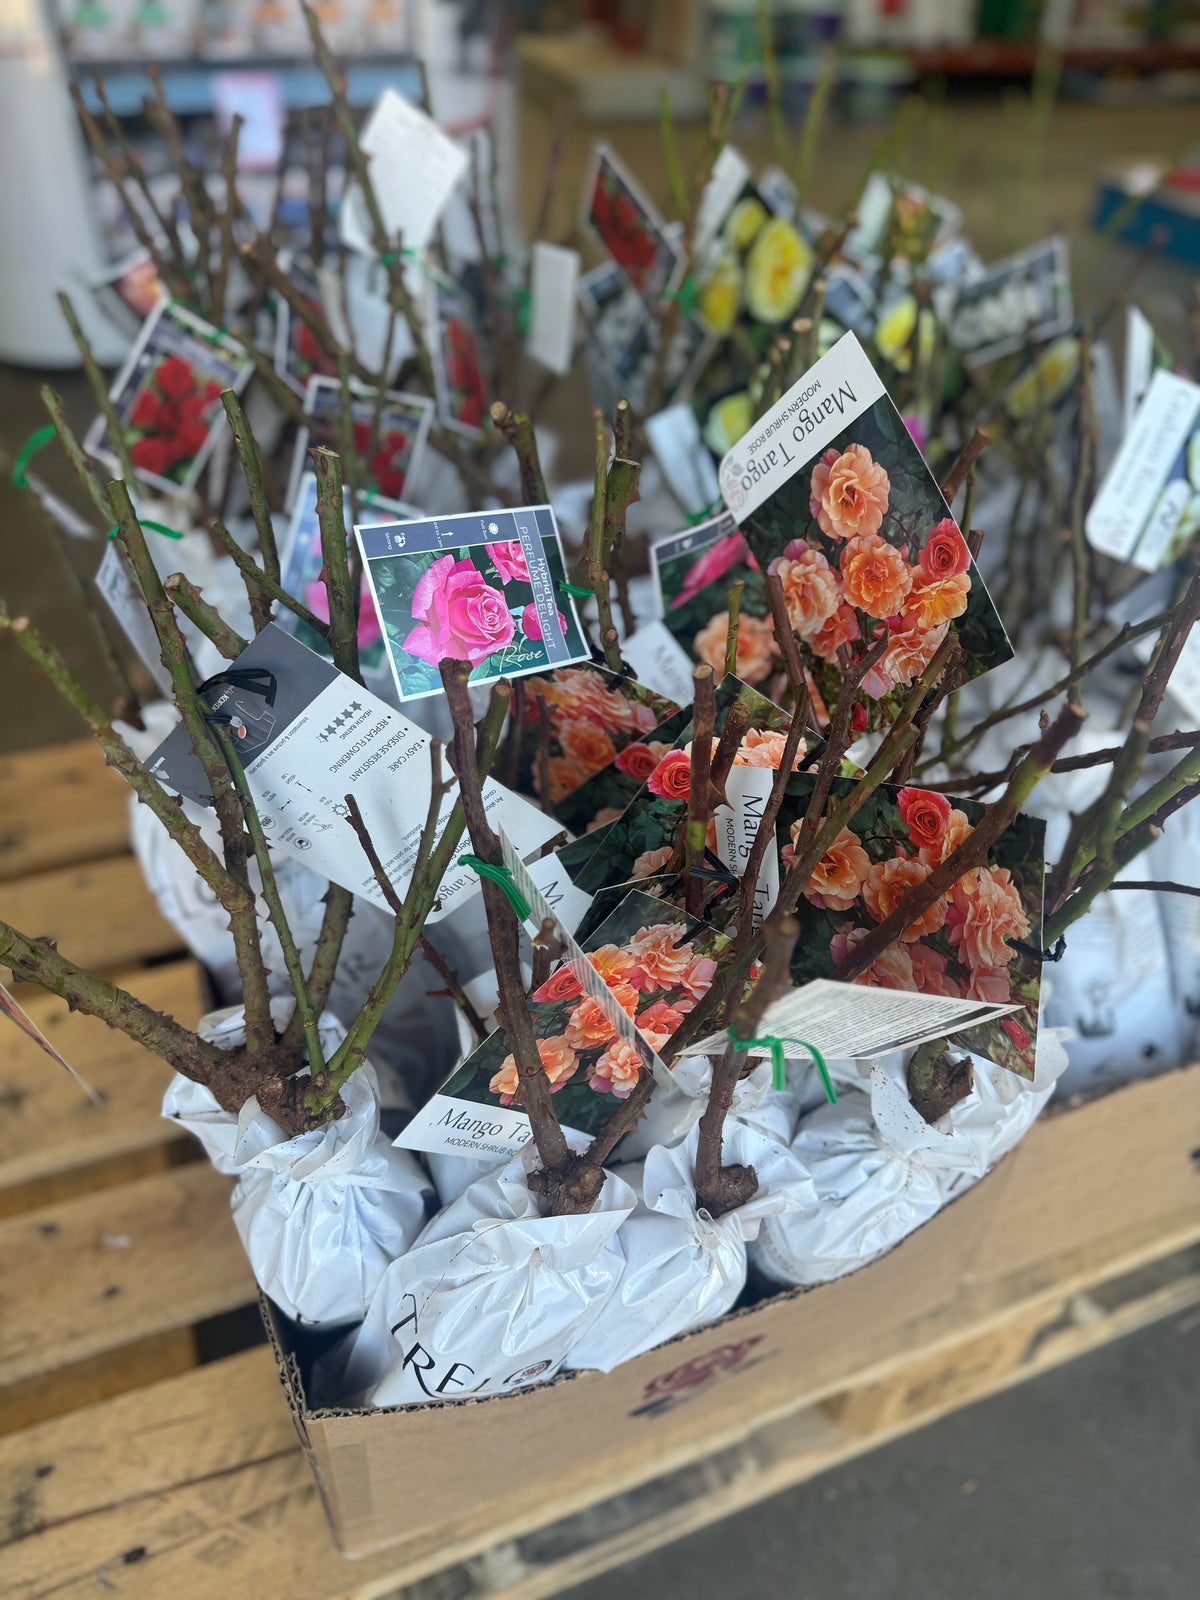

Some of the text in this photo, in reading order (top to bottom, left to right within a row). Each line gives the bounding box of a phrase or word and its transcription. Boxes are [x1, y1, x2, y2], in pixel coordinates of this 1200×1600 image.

[750, 380, 821, 455] MODERN SHRUB ROSE
[741, 381, 857, 490] Mango Tango
[519, 526, 556, 649] PERFUME DELIGHT
[537, 558, 554, 616] Hybrid Tea
[495, 646, 544, 672] Rose
[339, 708, 372, 740] HEALTH RATING
[272, 738, 286, 751] picture
[328, 717, 388, 774] REPEAT FLOWERING
[348, 729, 405, 782] DISEASE RESISTANT
[387, 741, 422, 772] EASY CARE
[453, 836, 472, 856] odern
[725, 818, 736, 862] MODERN
[438, 875, 479, 900] Tango
[437, 1107, 503, 1139] Mango
[444, 1137, 480, 1149] MODERN
[480, 1144, 508, 1154] SHRUB
